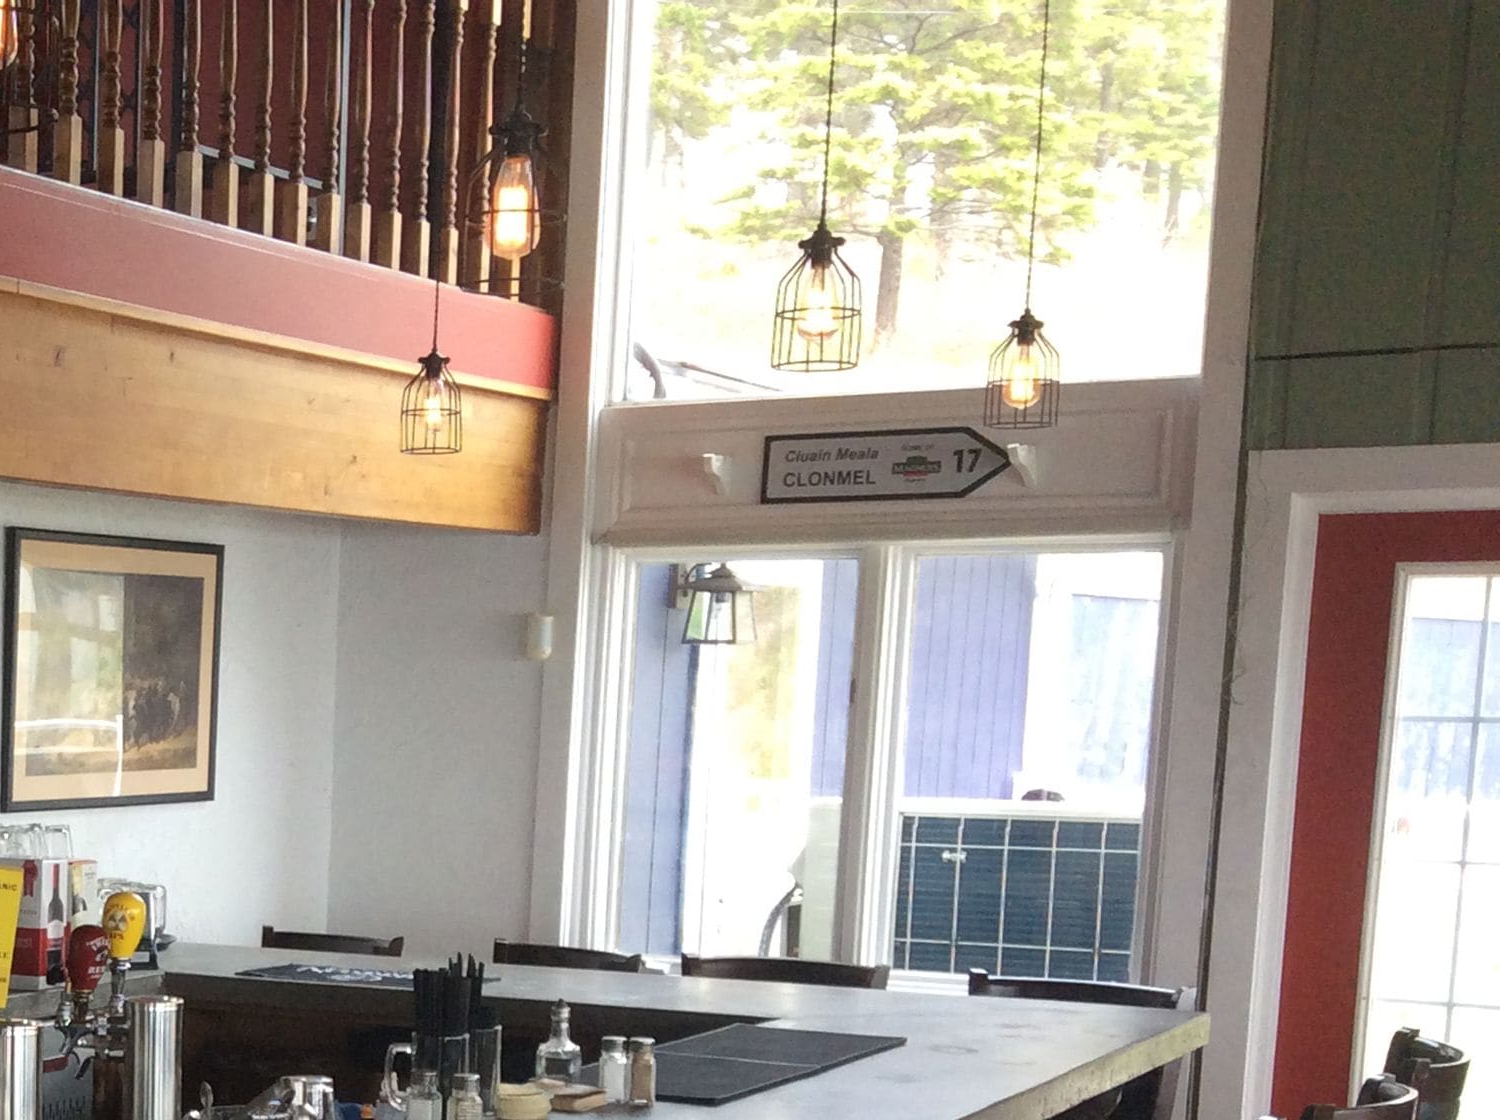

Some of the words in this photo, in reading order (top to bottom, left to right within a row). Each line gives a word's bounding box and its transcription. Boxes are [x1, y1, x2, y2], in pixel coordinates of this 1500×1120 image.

[785, 449, 831, 463] Cluain
[835, 448, 879, 462] Meala
[953, 448, 982, 473] 17
[783, 470, 876, 488] CLONMEL
